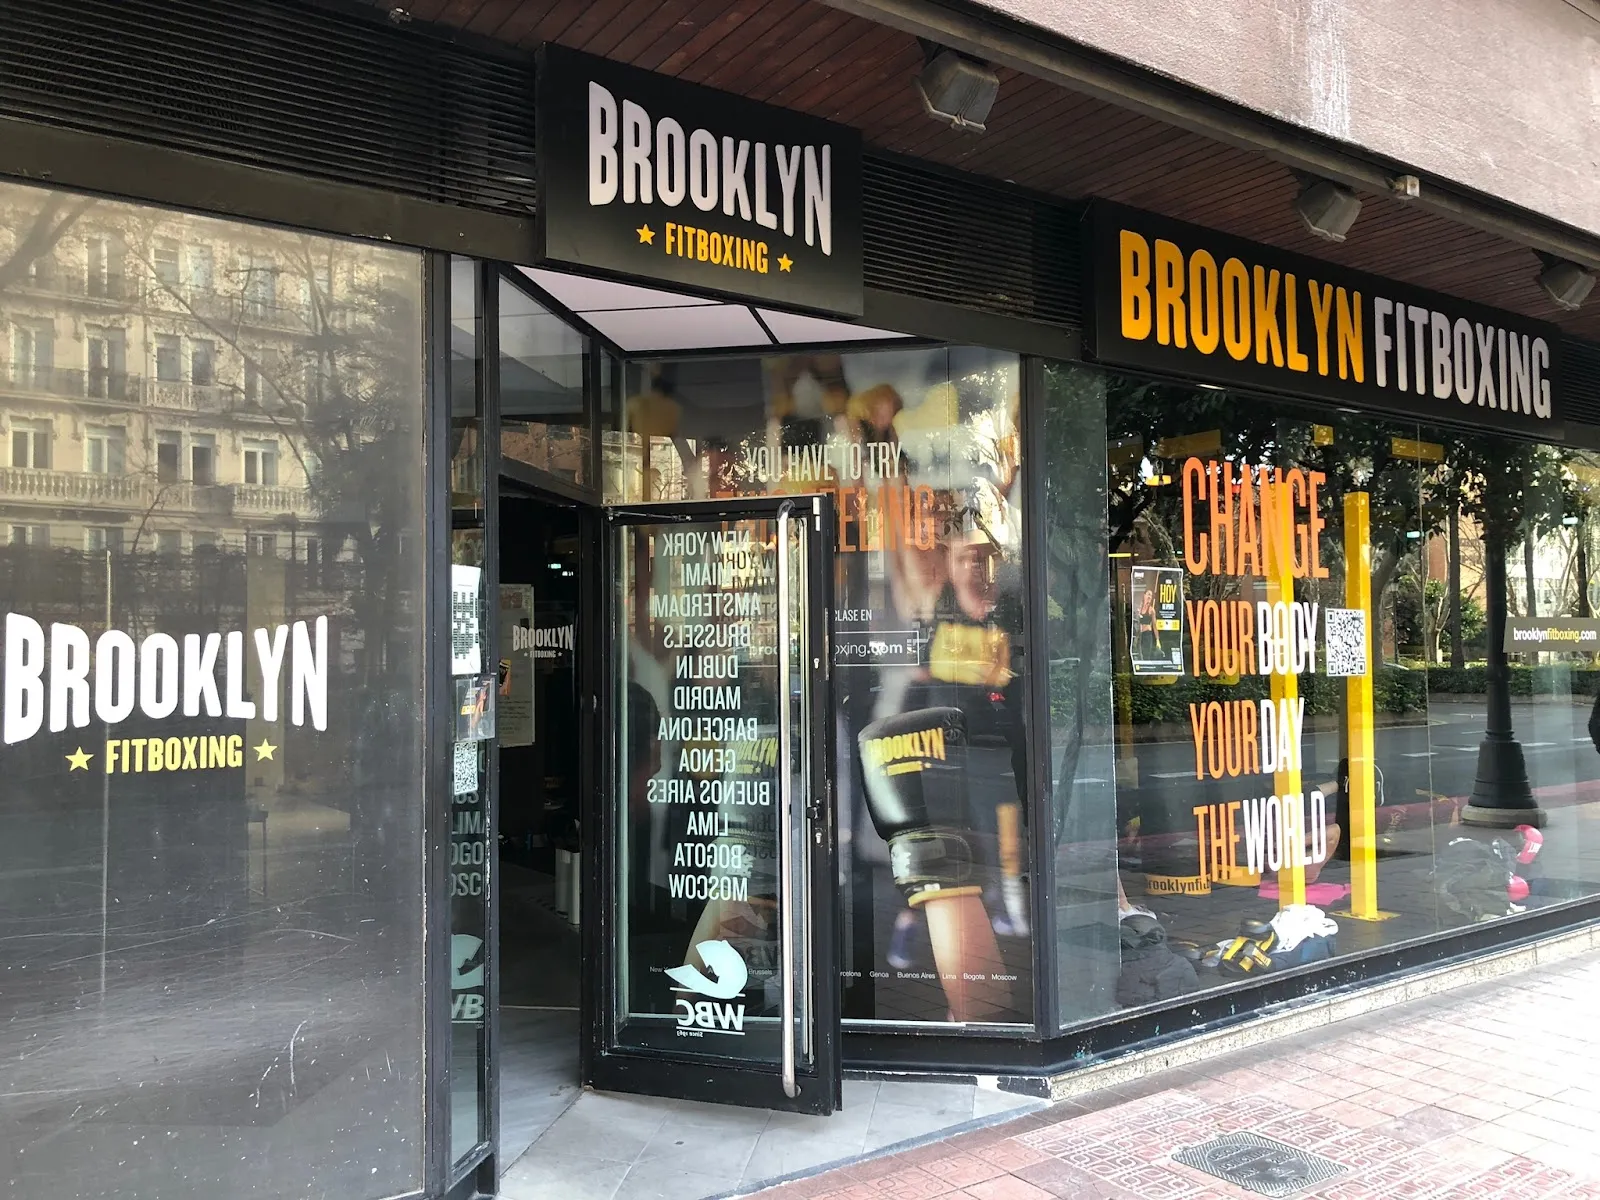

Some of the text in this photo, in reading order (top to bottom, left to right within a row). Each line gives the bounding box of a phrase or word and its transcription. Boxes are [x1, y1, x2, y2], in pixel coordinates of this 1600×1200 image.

[589, 81, 832, 256] BROOKLYN
[665, 222, 768, 273] FITBOXING
[1119, 229, 1552, 419] BROOKLYN FITBOXING
[747, 441, 902, 483] YOU HAVE TO TRY
[1182, 456, 1329, 578] CHANGE
[512, 624, 573, 651] BROOKLYN
[862, 608, 873, 621] EN
[1186, 600, 1319, 677] YOUR BODY
[1513, 627, 1597, 643] brooklynfitboxing.com
[4, 612, 328, 745] BROOKLYN
[106, 734, 243, 774] FITBOXING
[1189, 697, 1304, 780] YOUR DAY
[1193, 790, 1326, 885] THE WORLD
[869, 971, 889, 979] Genoa
[921, 972, 936, 980] Aires
[963, 973, 986, 982] Bogota
[991, 974, 1018, 982] Moscow
